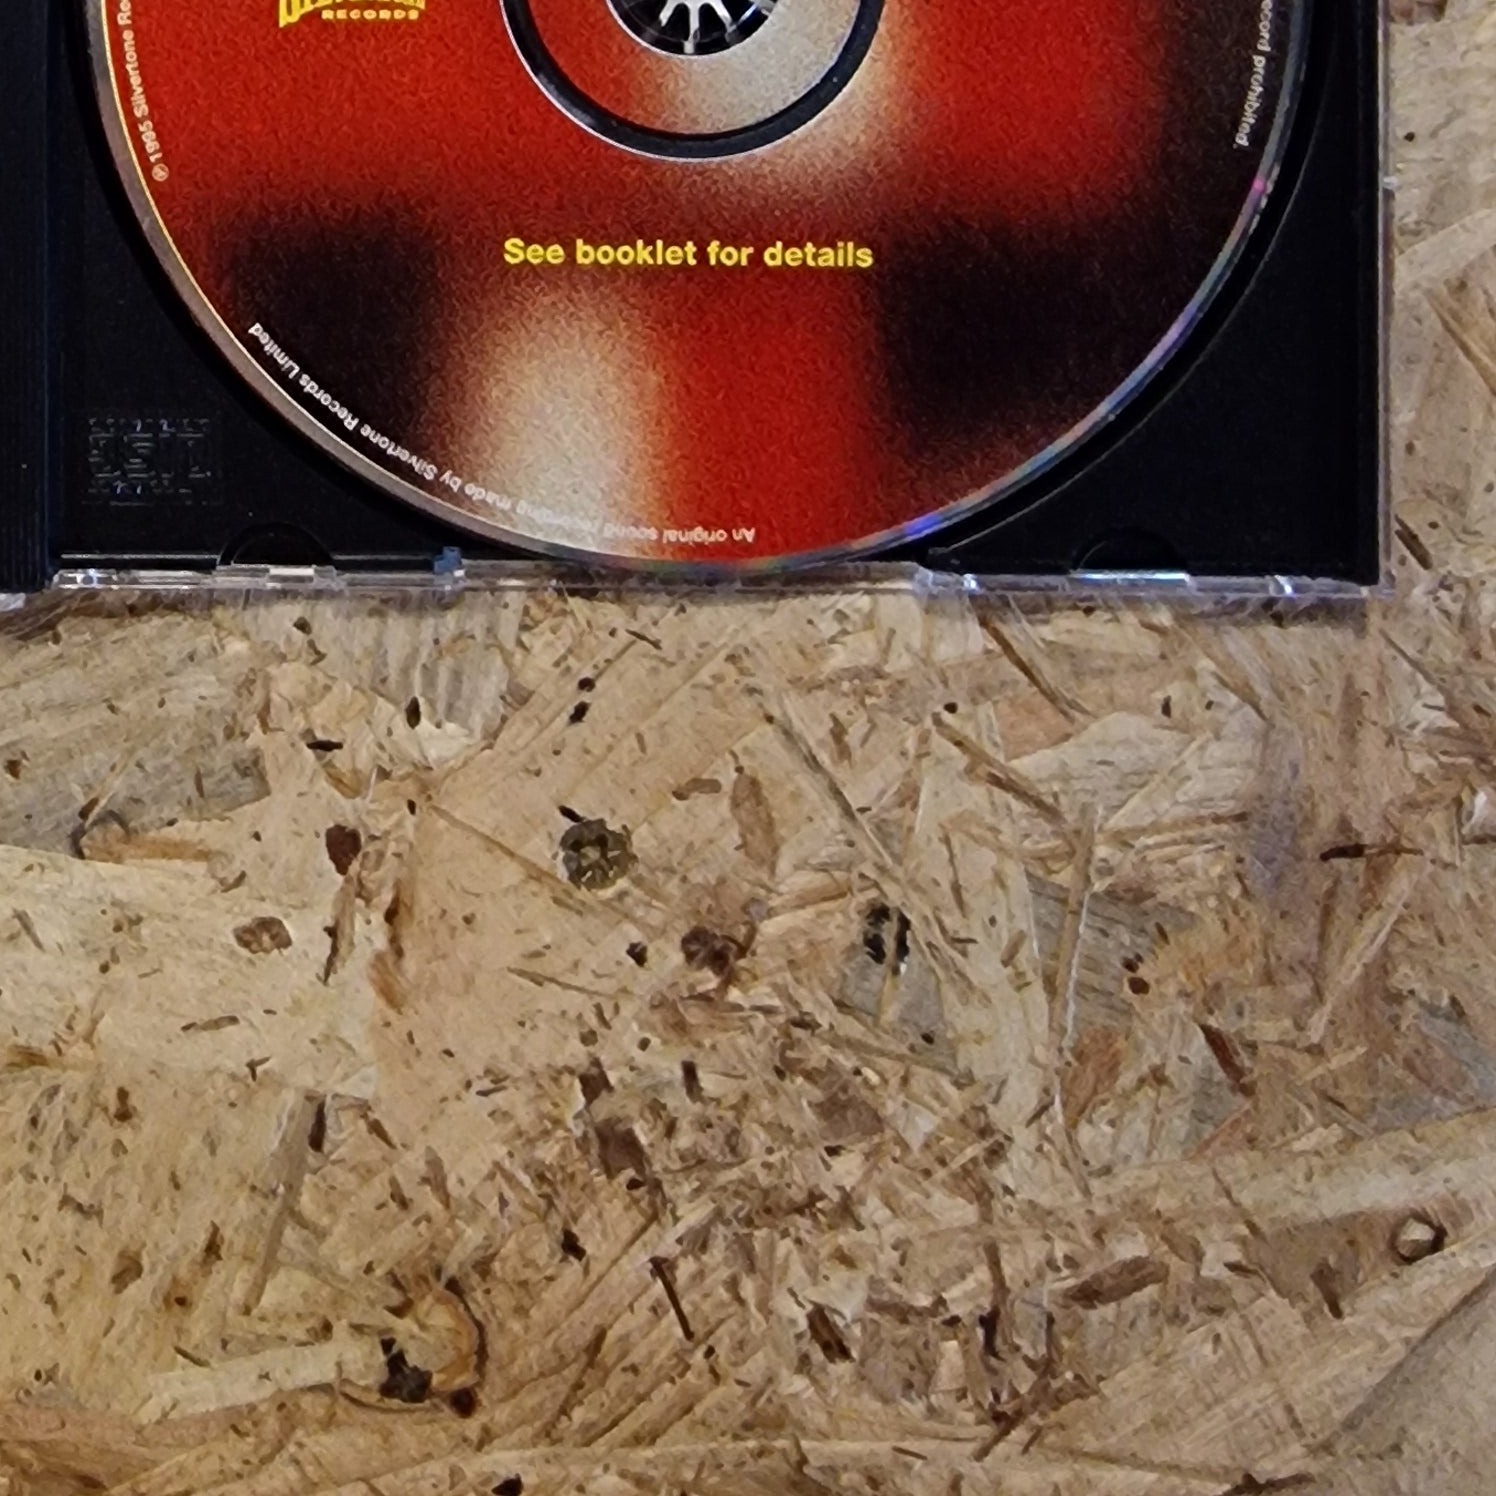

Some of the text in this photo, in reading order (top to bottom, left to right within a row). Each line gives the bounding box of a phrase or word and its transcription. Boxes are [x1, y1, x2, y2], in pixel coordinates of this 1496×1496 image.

[321, 9, 420, 20] RECORDS
[120, 29, 150, 117] Silvertone
[1230, 55, 1268, 152] prohibited.
[504, 237, 875, 268] See booklet for details
[247, 321, 300, 378] Limited
[296, 372, 359, 429] Records
[357, 422, 438, 479] Silvertone
[438, 467, 463, 491] by
[462, 481, 511, 511] made
[663, 526, 726, 542] original
[732, 527, 755, 541] An
